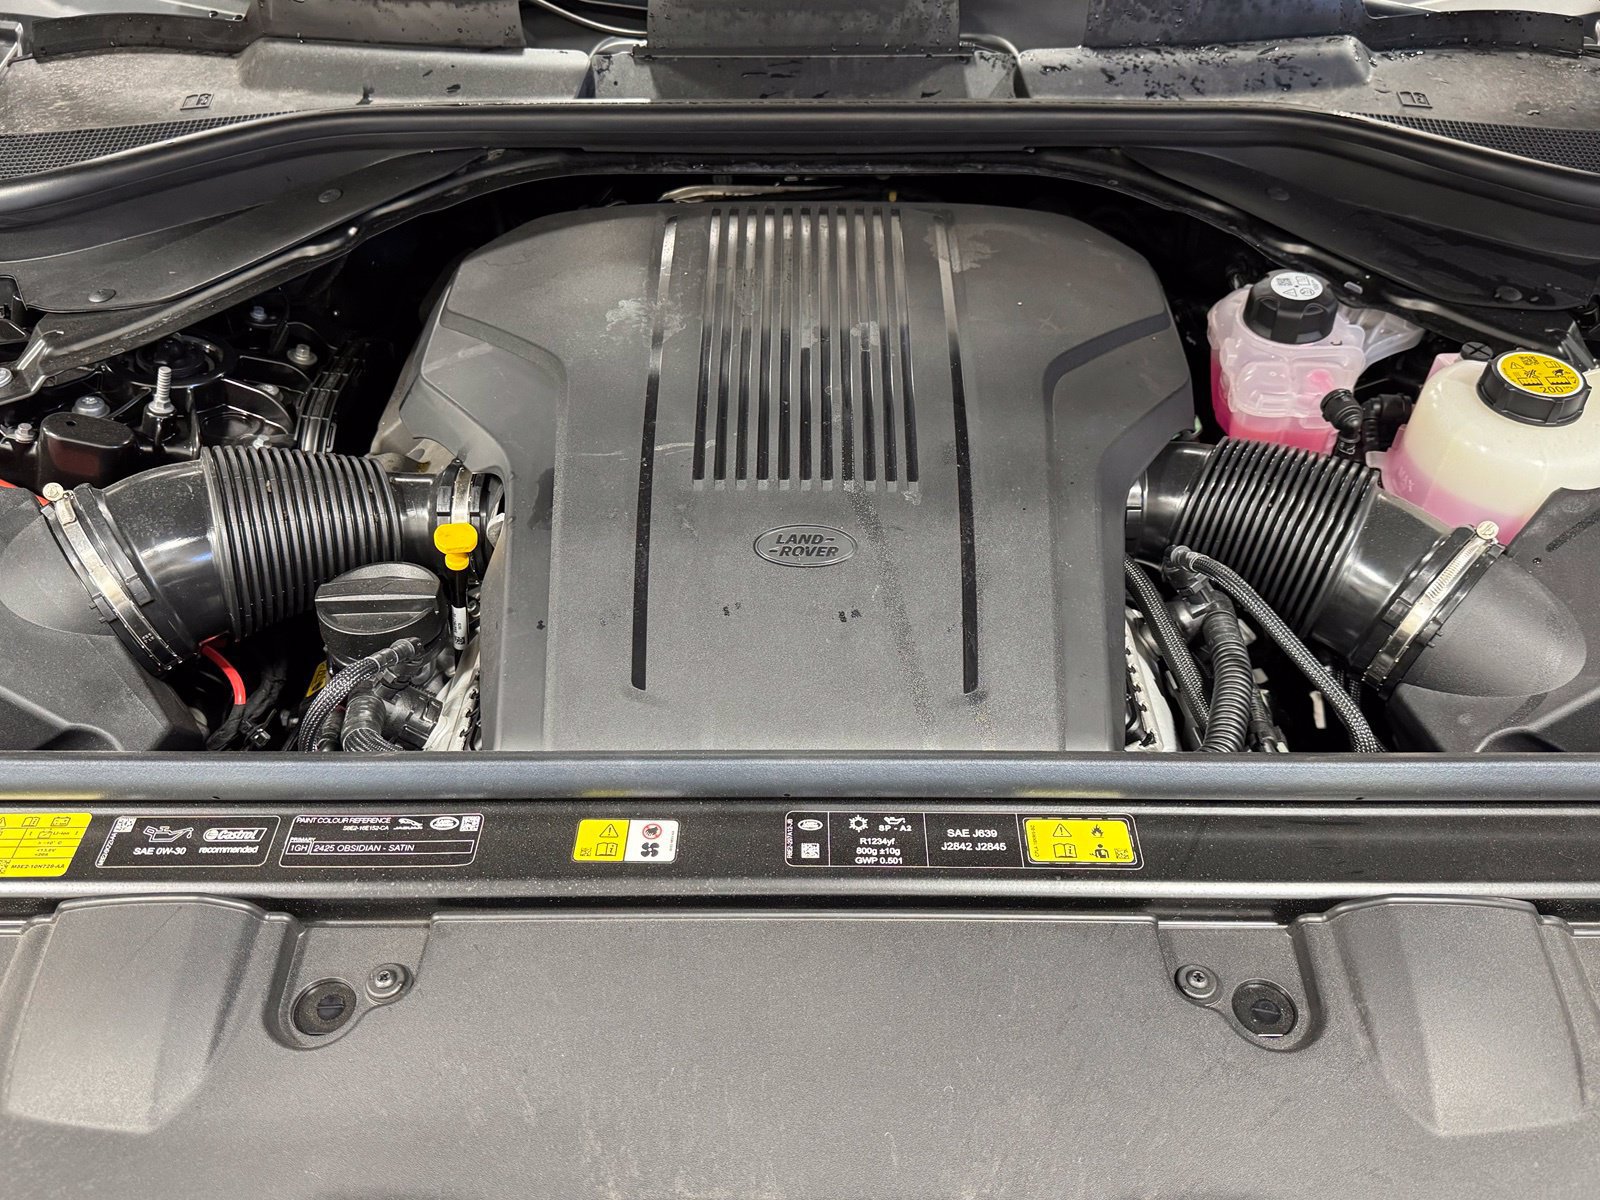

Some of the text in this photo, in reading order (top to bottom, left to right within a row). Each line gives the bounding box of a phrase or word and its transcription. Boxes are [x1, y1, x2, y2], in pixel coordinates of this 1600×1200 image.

[776, 534, 824, 545] LAND
[779, 546, 839, 557] ROVER
[217, 828, 258, 840] Castrol
[947, 829, 998, 837] SAE J639
[860, 838, 896, 846] R1234yf
[199, 846, 259, 854] recommended
[290, 844, 308, 852] 1GH
[313, 844, 335, 852] 2425
[337, 844, 381, 852] OBSIDIAN
[388, 844, 415, 852] SATIN
[941, 842, 1007, 851] J2842 J2845
[133, 847, 187, 855] SAE 0W-30
[856, 847, 901, 856] 800g ±10g
